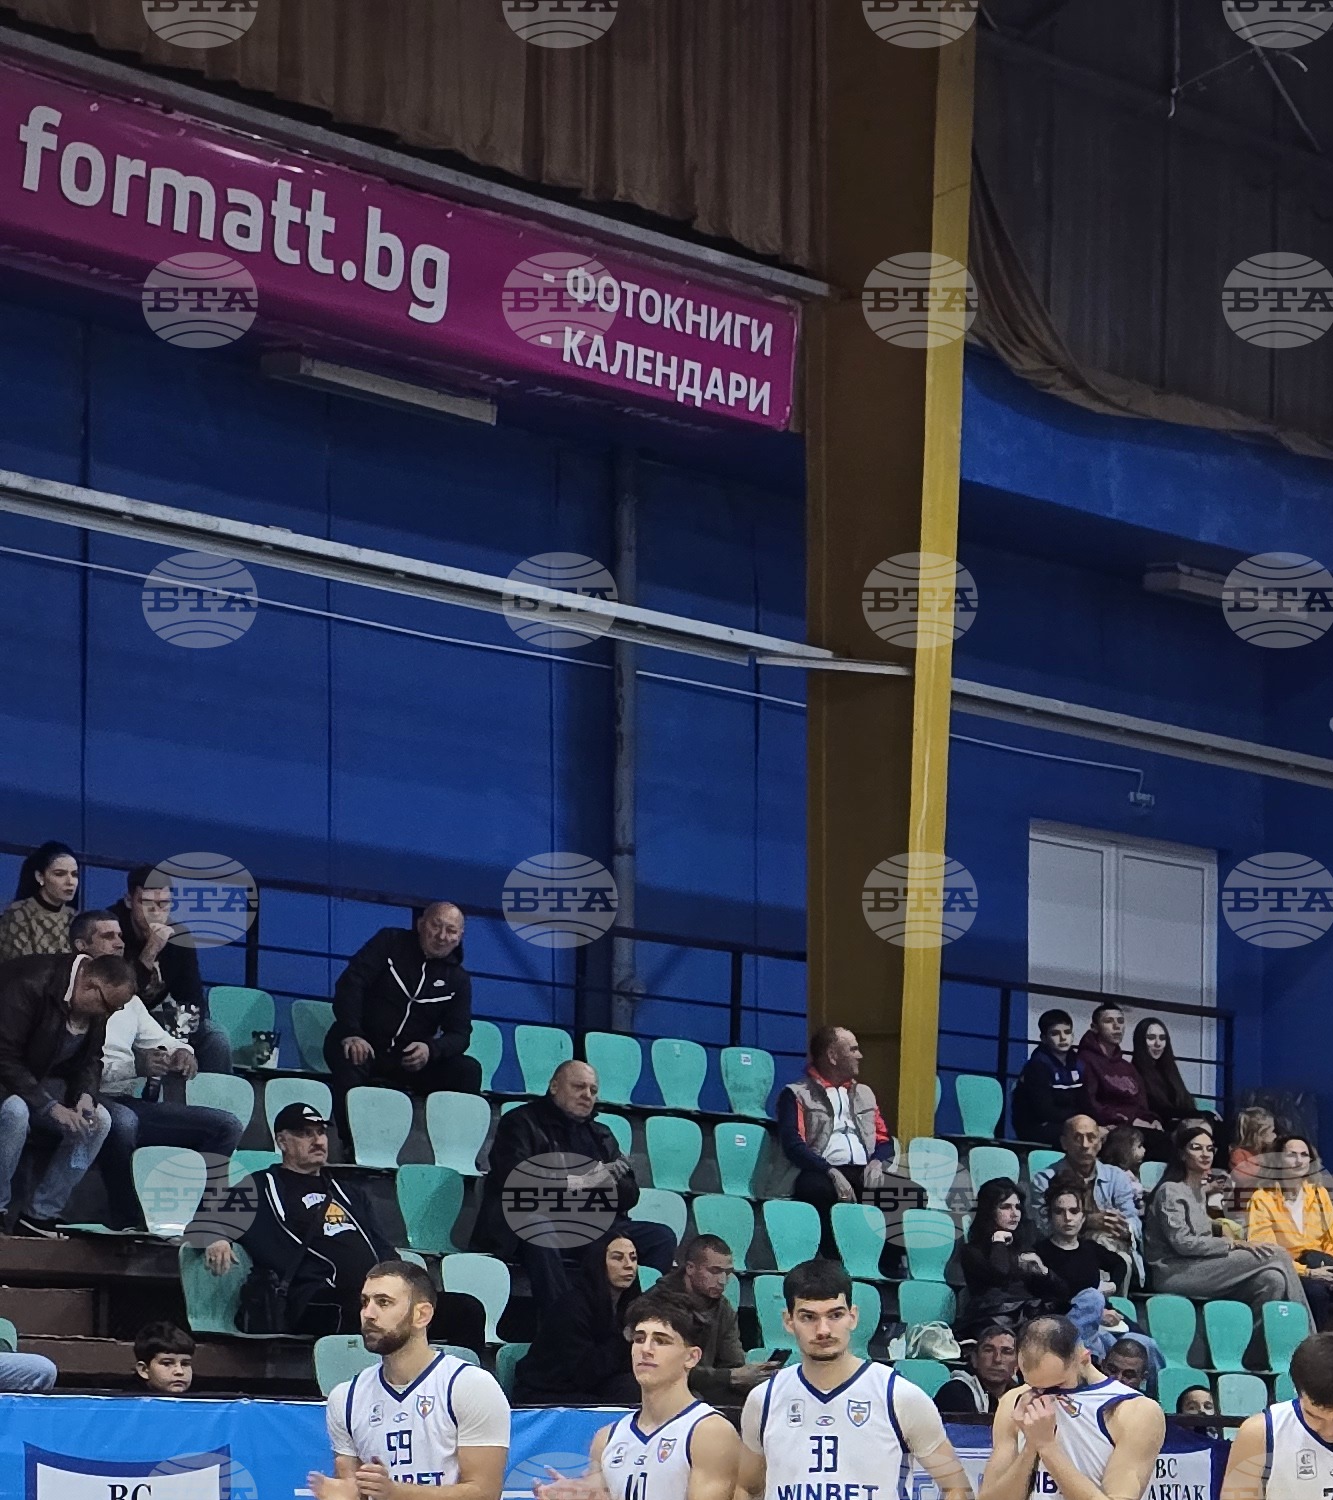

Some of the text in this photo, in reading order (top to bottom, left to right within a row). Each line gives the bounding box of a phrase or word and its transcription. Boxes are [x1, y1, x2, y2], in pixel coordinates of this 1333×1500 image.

[18, 104, 452, 324] formatt.bg
[565, 264, 774, 358] ФОТОКНИГИ
[561, 328, 772, 416] КАЛЕНДАРИ
[807, 1435, 839, 1474] 33
[1155, 1457, 1178, 1480] BC
